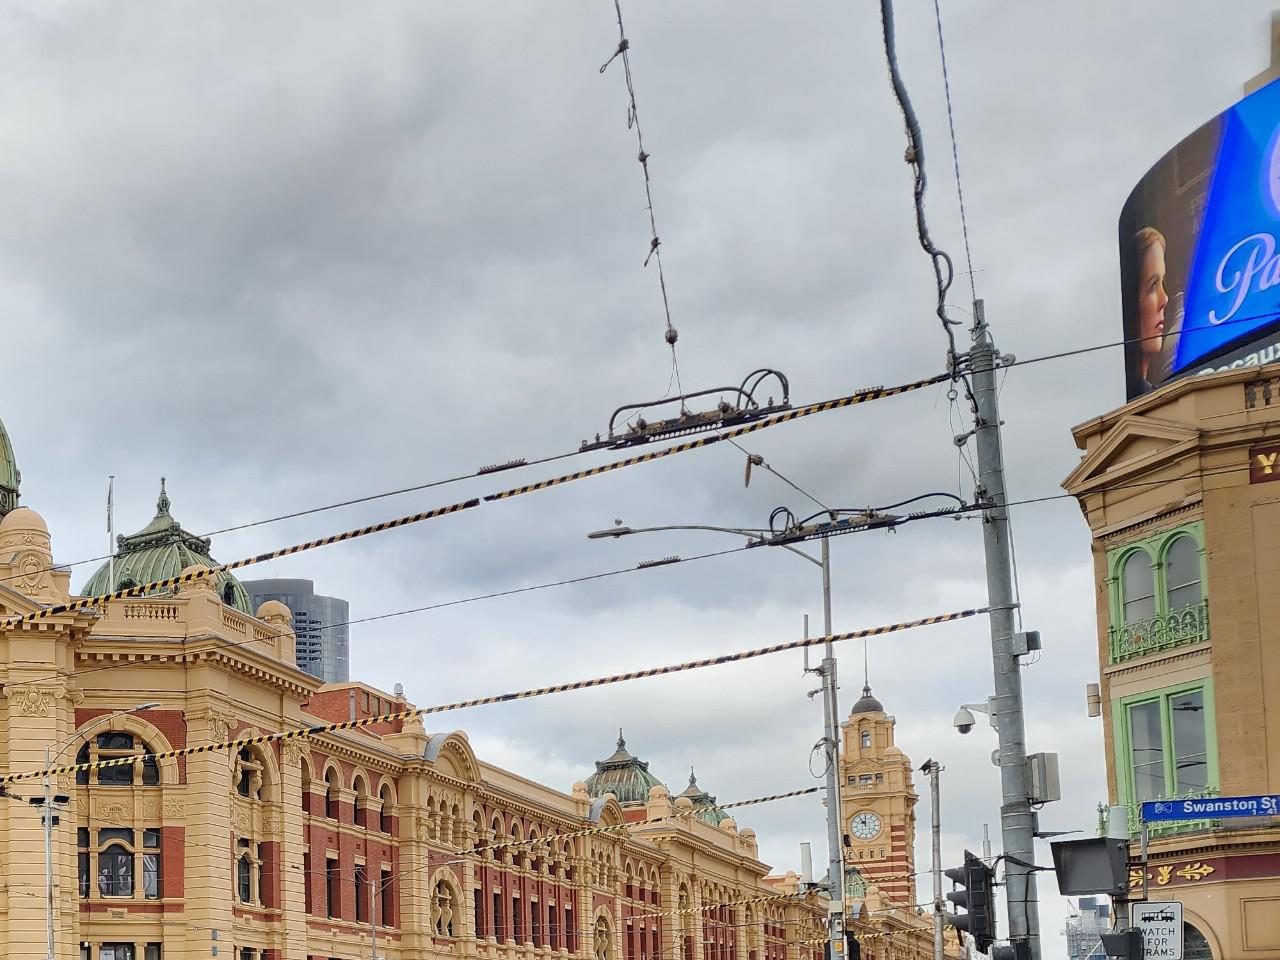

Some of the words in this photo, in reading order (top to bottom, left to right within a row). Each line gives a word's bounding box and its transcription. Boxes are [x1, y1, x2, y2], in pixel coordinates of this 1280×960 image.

[1183, 799, 1257, 813] Swanston
[1261, 797, 1277, 809] St
[1140, 927, 1175, 936] WATCH
[1147, 938, 1168, 947] FOR
